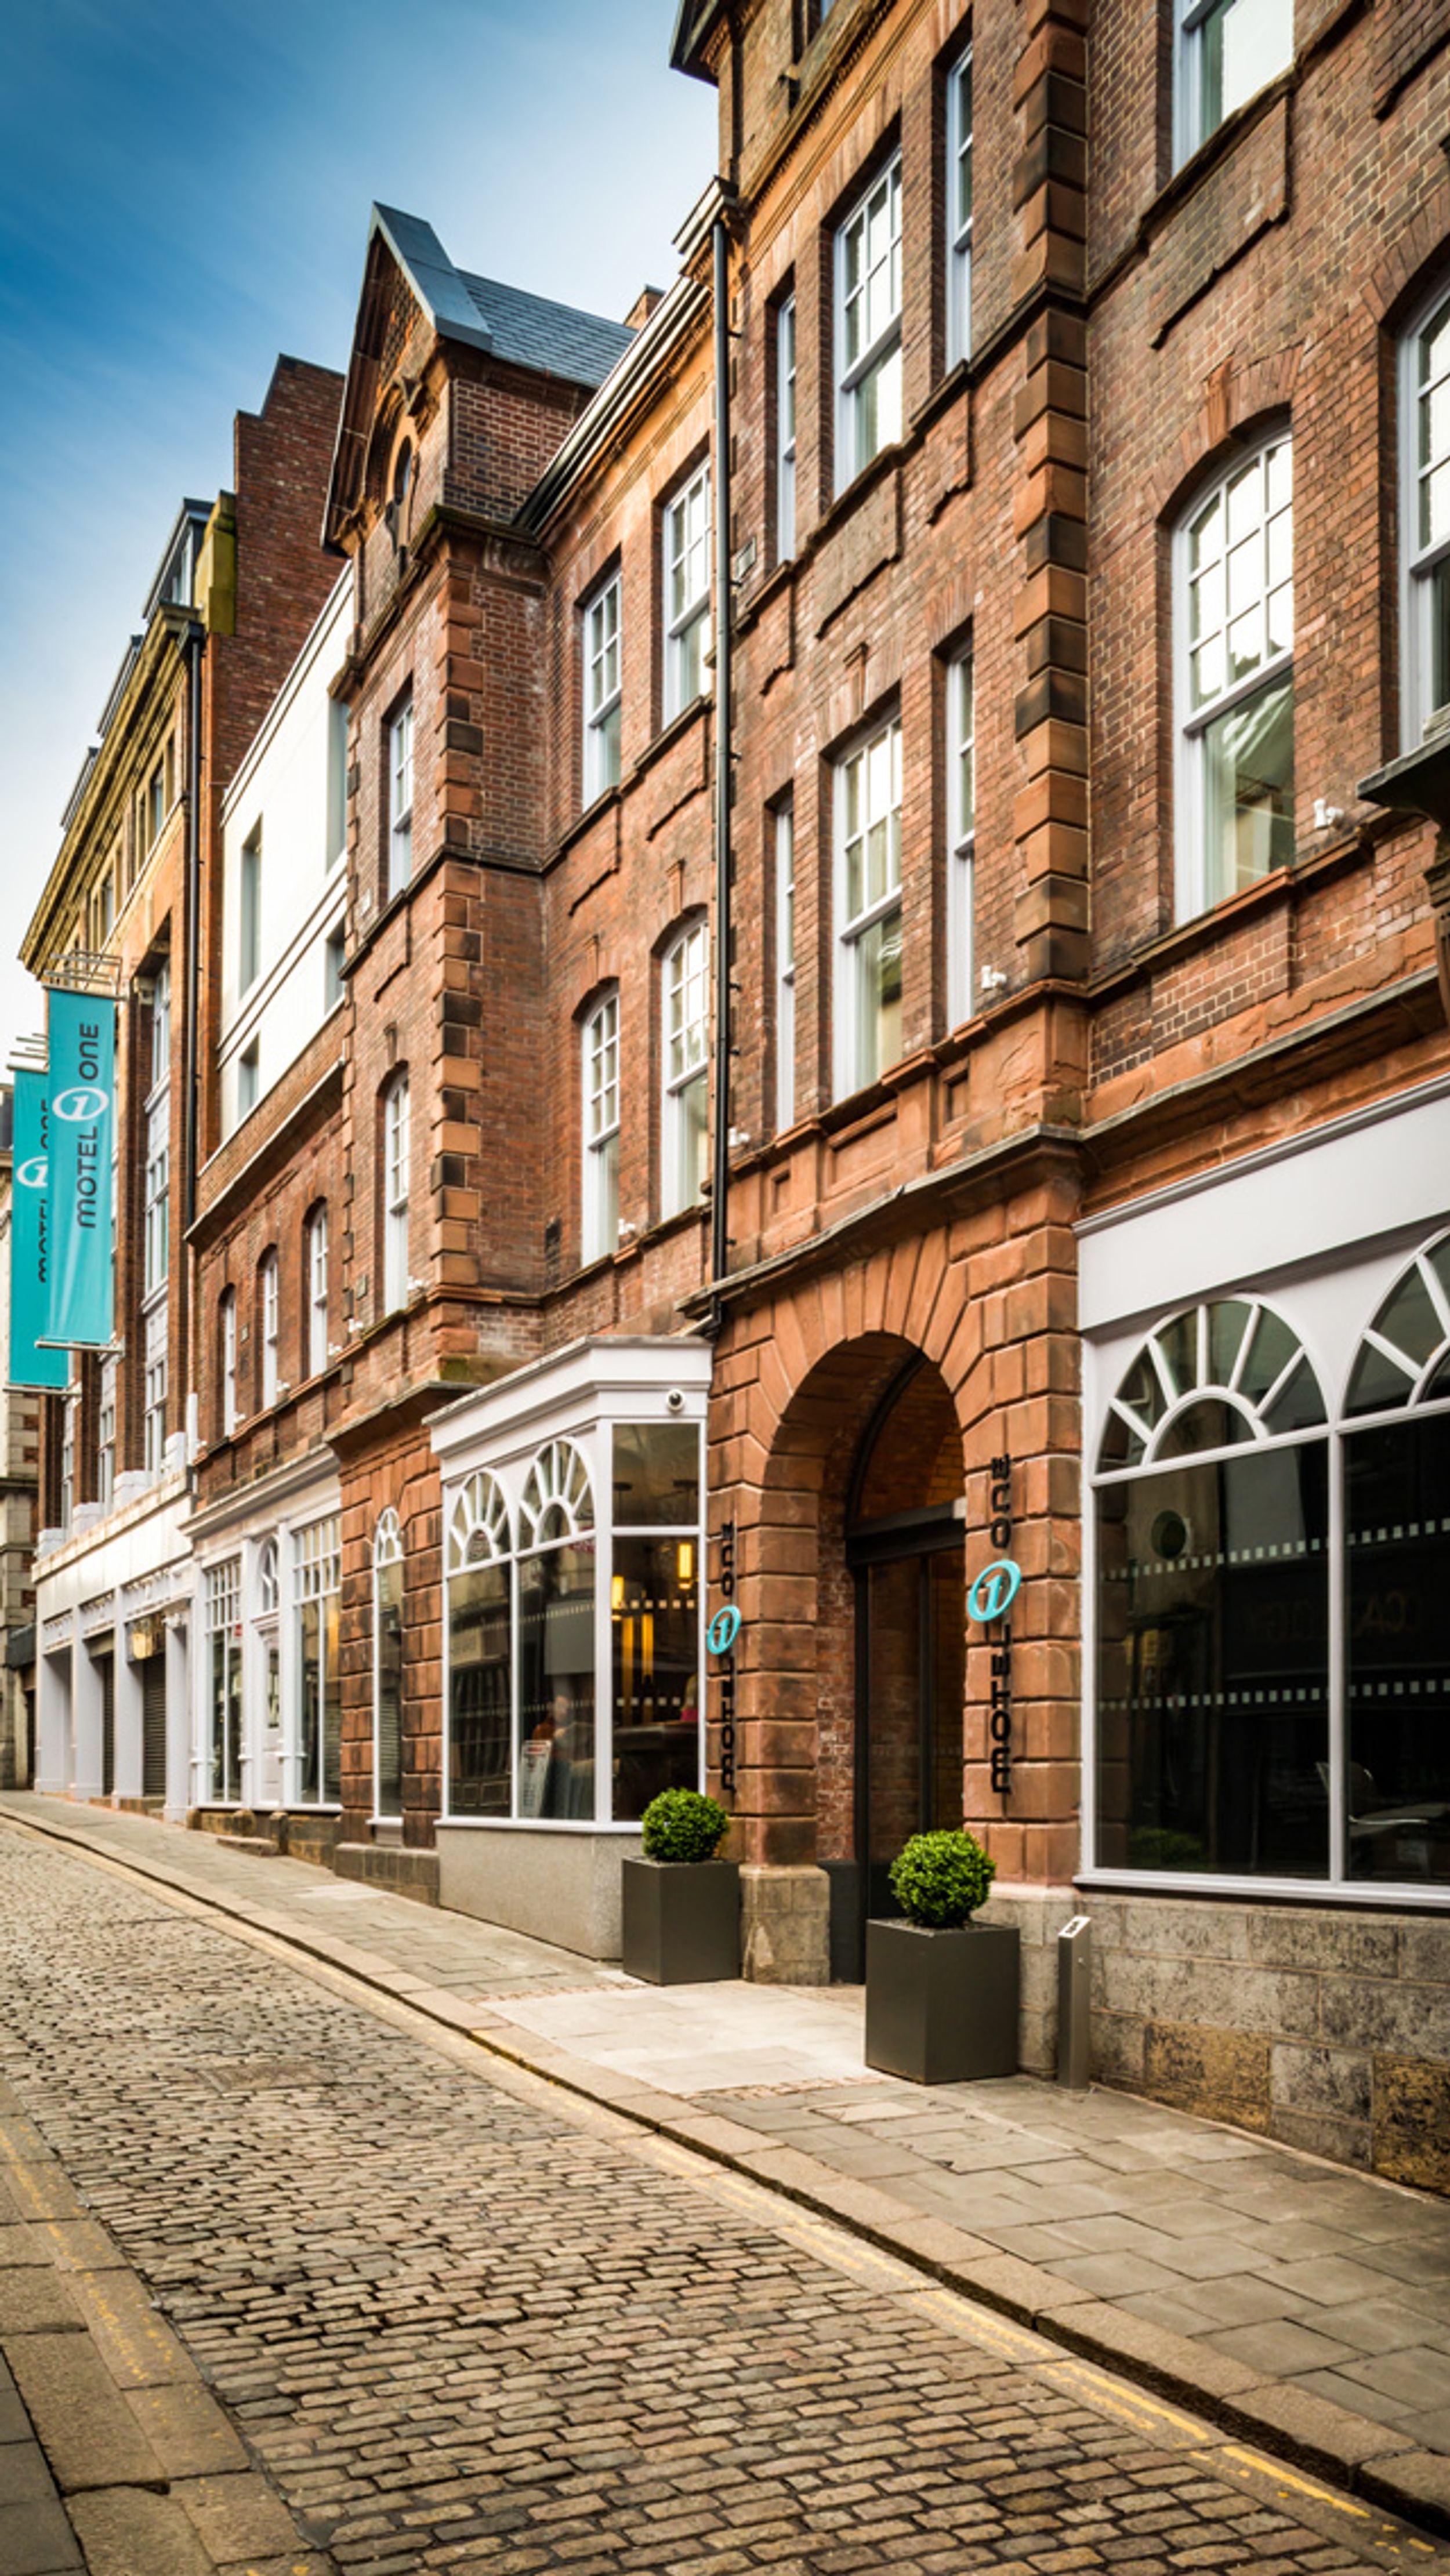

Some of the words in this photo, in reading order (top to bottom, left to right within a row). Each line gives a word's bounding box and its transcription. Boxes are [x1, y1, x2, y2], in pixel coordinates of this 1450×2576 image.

[78, 1023, 99, 1081] ONE
[77, 1126, 98, 1229] MOTEL
[990, 1453, 1010, 1549] ONE
[721, 1656, 735, 1791] MOTEL
[991, 1624, 1011, 1794] MOTEL
